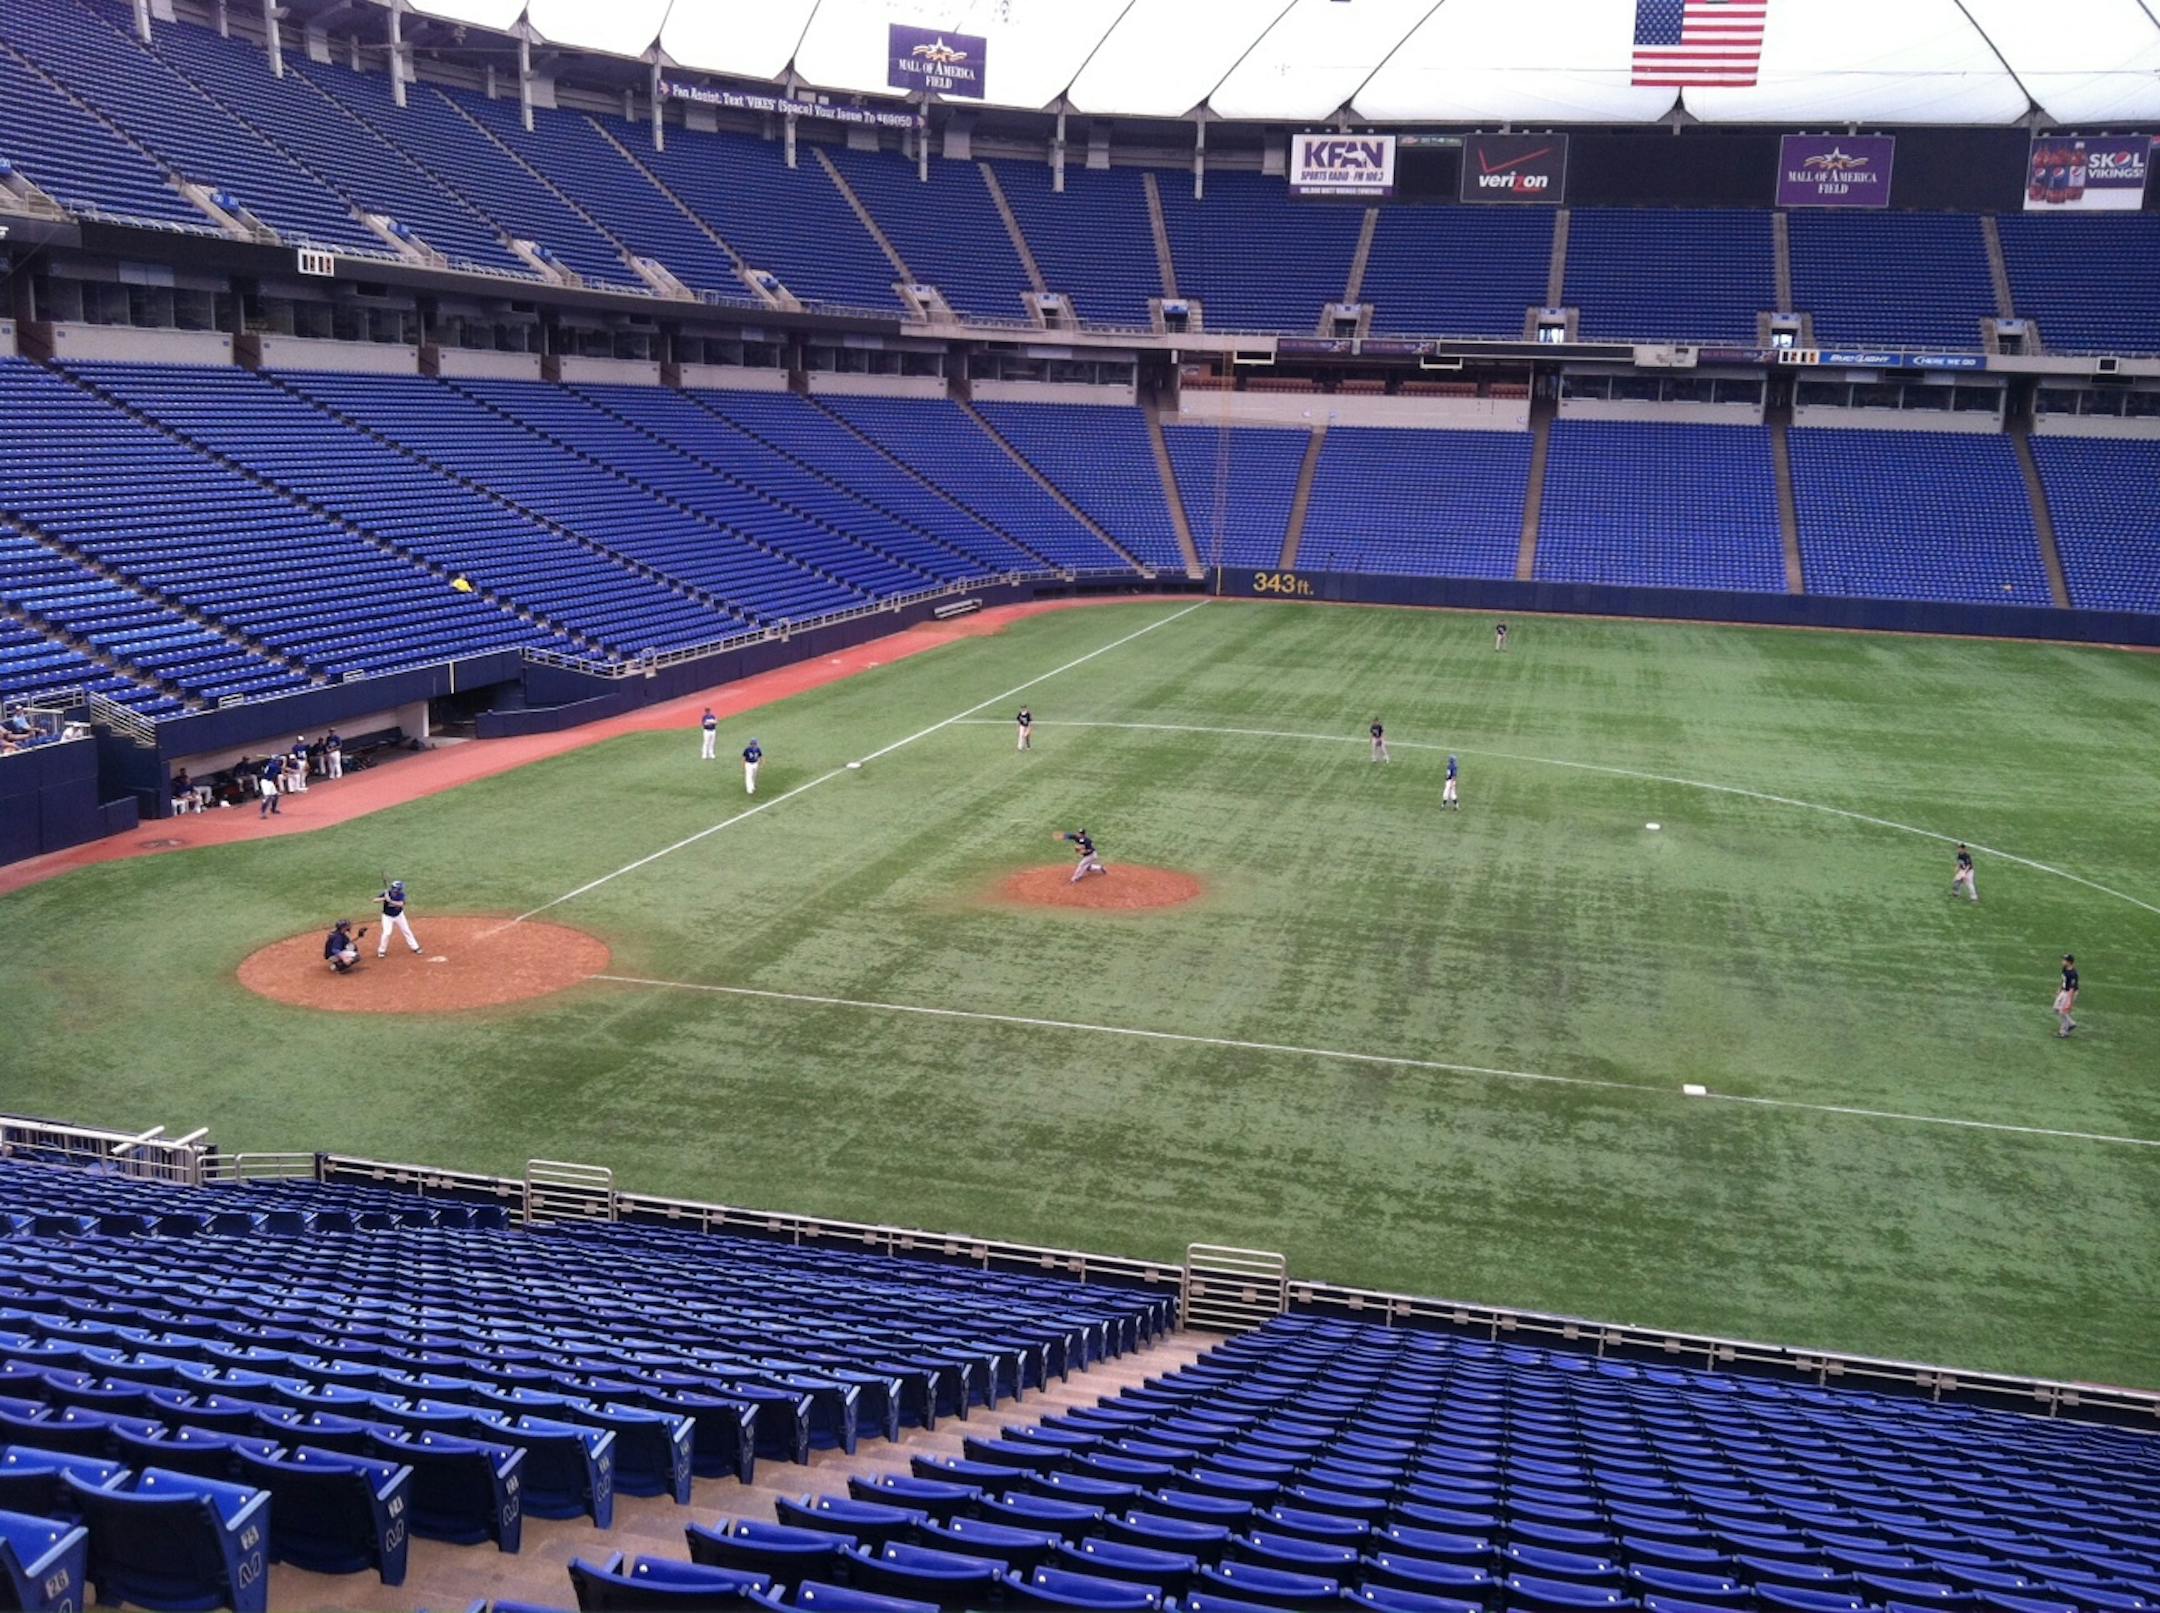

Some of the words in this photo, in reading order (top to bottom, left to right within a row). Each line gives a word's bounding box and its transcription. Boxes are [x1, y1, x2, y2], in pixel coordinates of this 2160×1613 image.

[899, 59, 921, 72] MALL
[922, 63, 935, 74] OF
[934, 61, 976, 80] AMERICA
[925, 75, 953, 89] FIELD
[672, 84, 690, 97] Fan
[723, 92, 744, 106] Text
[815, 103, 835, 119] Your
[863, 110, 876, 124] To
[1304, 141, 1384, 168] KFAN
[2088, 151, 2145, 168] SKOL
[1301, 171, 1328, 181] SPORTS
[1328, 171, 1349, 181] RADIO
[1478, 171, 1548, 191] verizon
[1788, 171, 1814, 182] MALL
[1814, 171, 1828, 182] OF
[1828, 169, 1878, 183] AMERICA
[1818, 183, 1849, 194] FIELD
[1253, 572, 1296, 593] 343
[47, 1569, 68, 1597] 26
